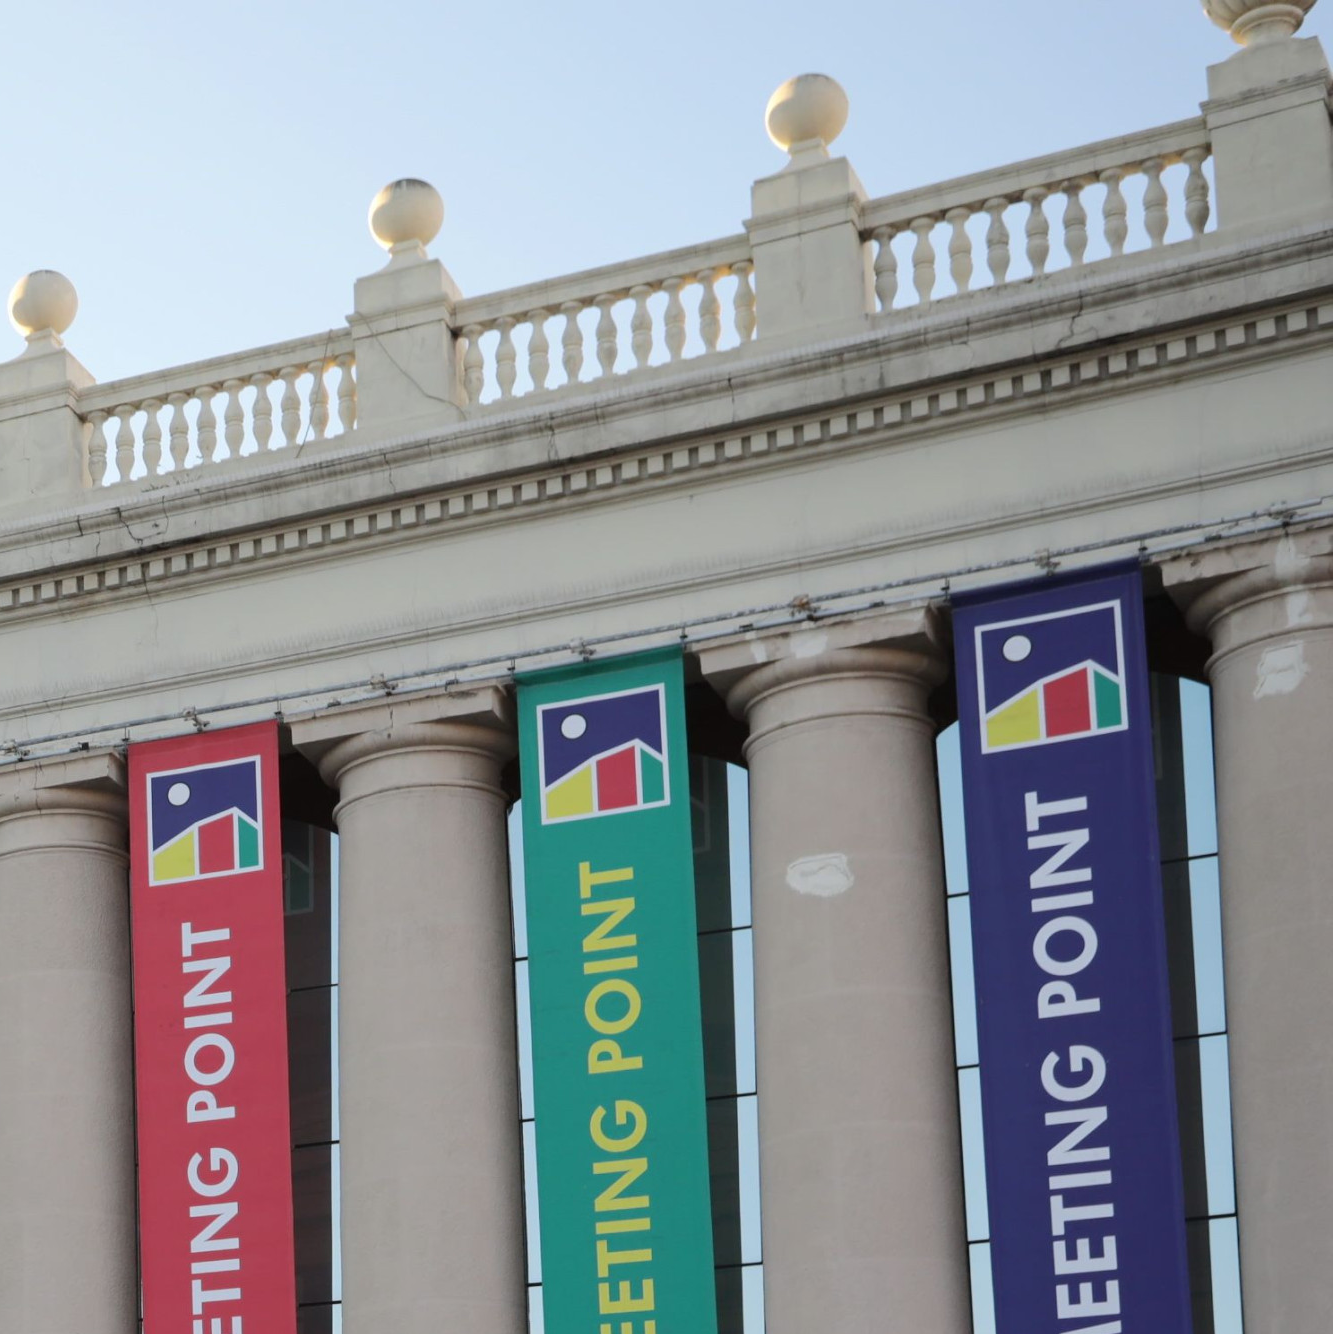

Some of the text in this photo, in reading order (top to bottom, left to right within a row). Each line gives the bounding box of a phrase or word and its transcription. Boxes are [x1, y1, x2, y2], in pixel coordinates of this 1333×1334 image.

[579, 863, 643, 1074] POINT
[1024, 791, 1101, 1020] POINT
[181, 921, 237, 1124] POINT
